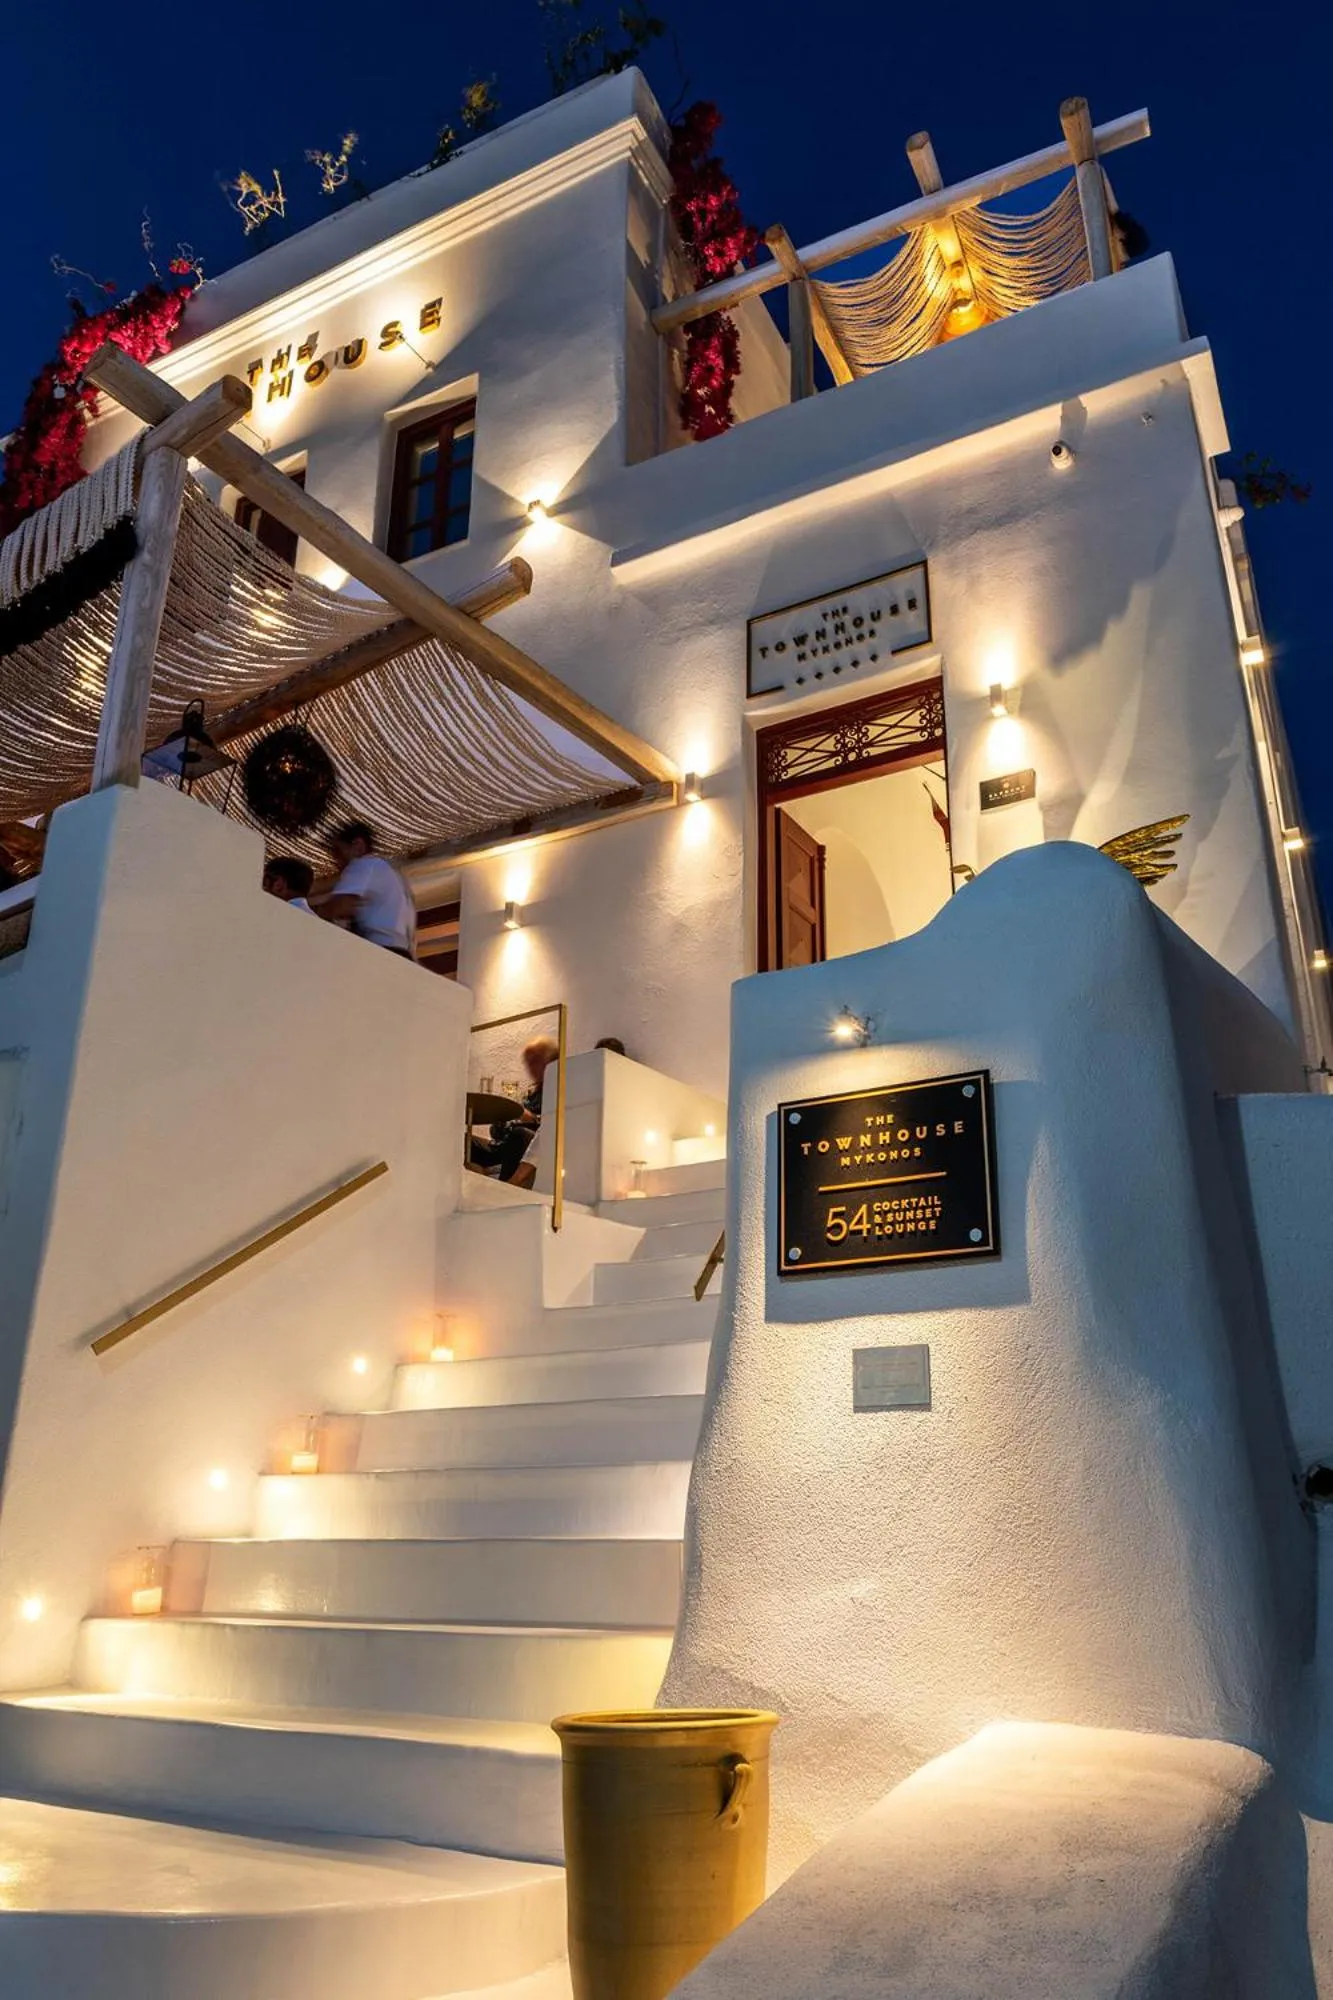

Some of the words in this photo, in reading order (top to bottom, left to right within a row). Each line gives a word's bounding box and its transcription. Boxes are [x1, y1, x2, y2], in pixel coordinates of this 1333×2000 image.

[246, 297, 444, 416] HOUSE
[822, 605, 849, 622] THE
[759, 598, 918, 659] TOWNHOUSE
[796, 628, 876, 662] MYKONOS
[865, 1114, 895, 1127] THE
[801, 1121, 964, 1156] TOWNHOUSE
[841, 1147, 921, 1167] MYKONOS
[873, 1195, 941, 1212] COCKTAIL
[826, 1204, 871, 1241] 54
[873, 1214, 883, 1223] &
[886, 1207, 941, 1221] SUNSET
[875, 1220, 937, 1236] LOUNGE
